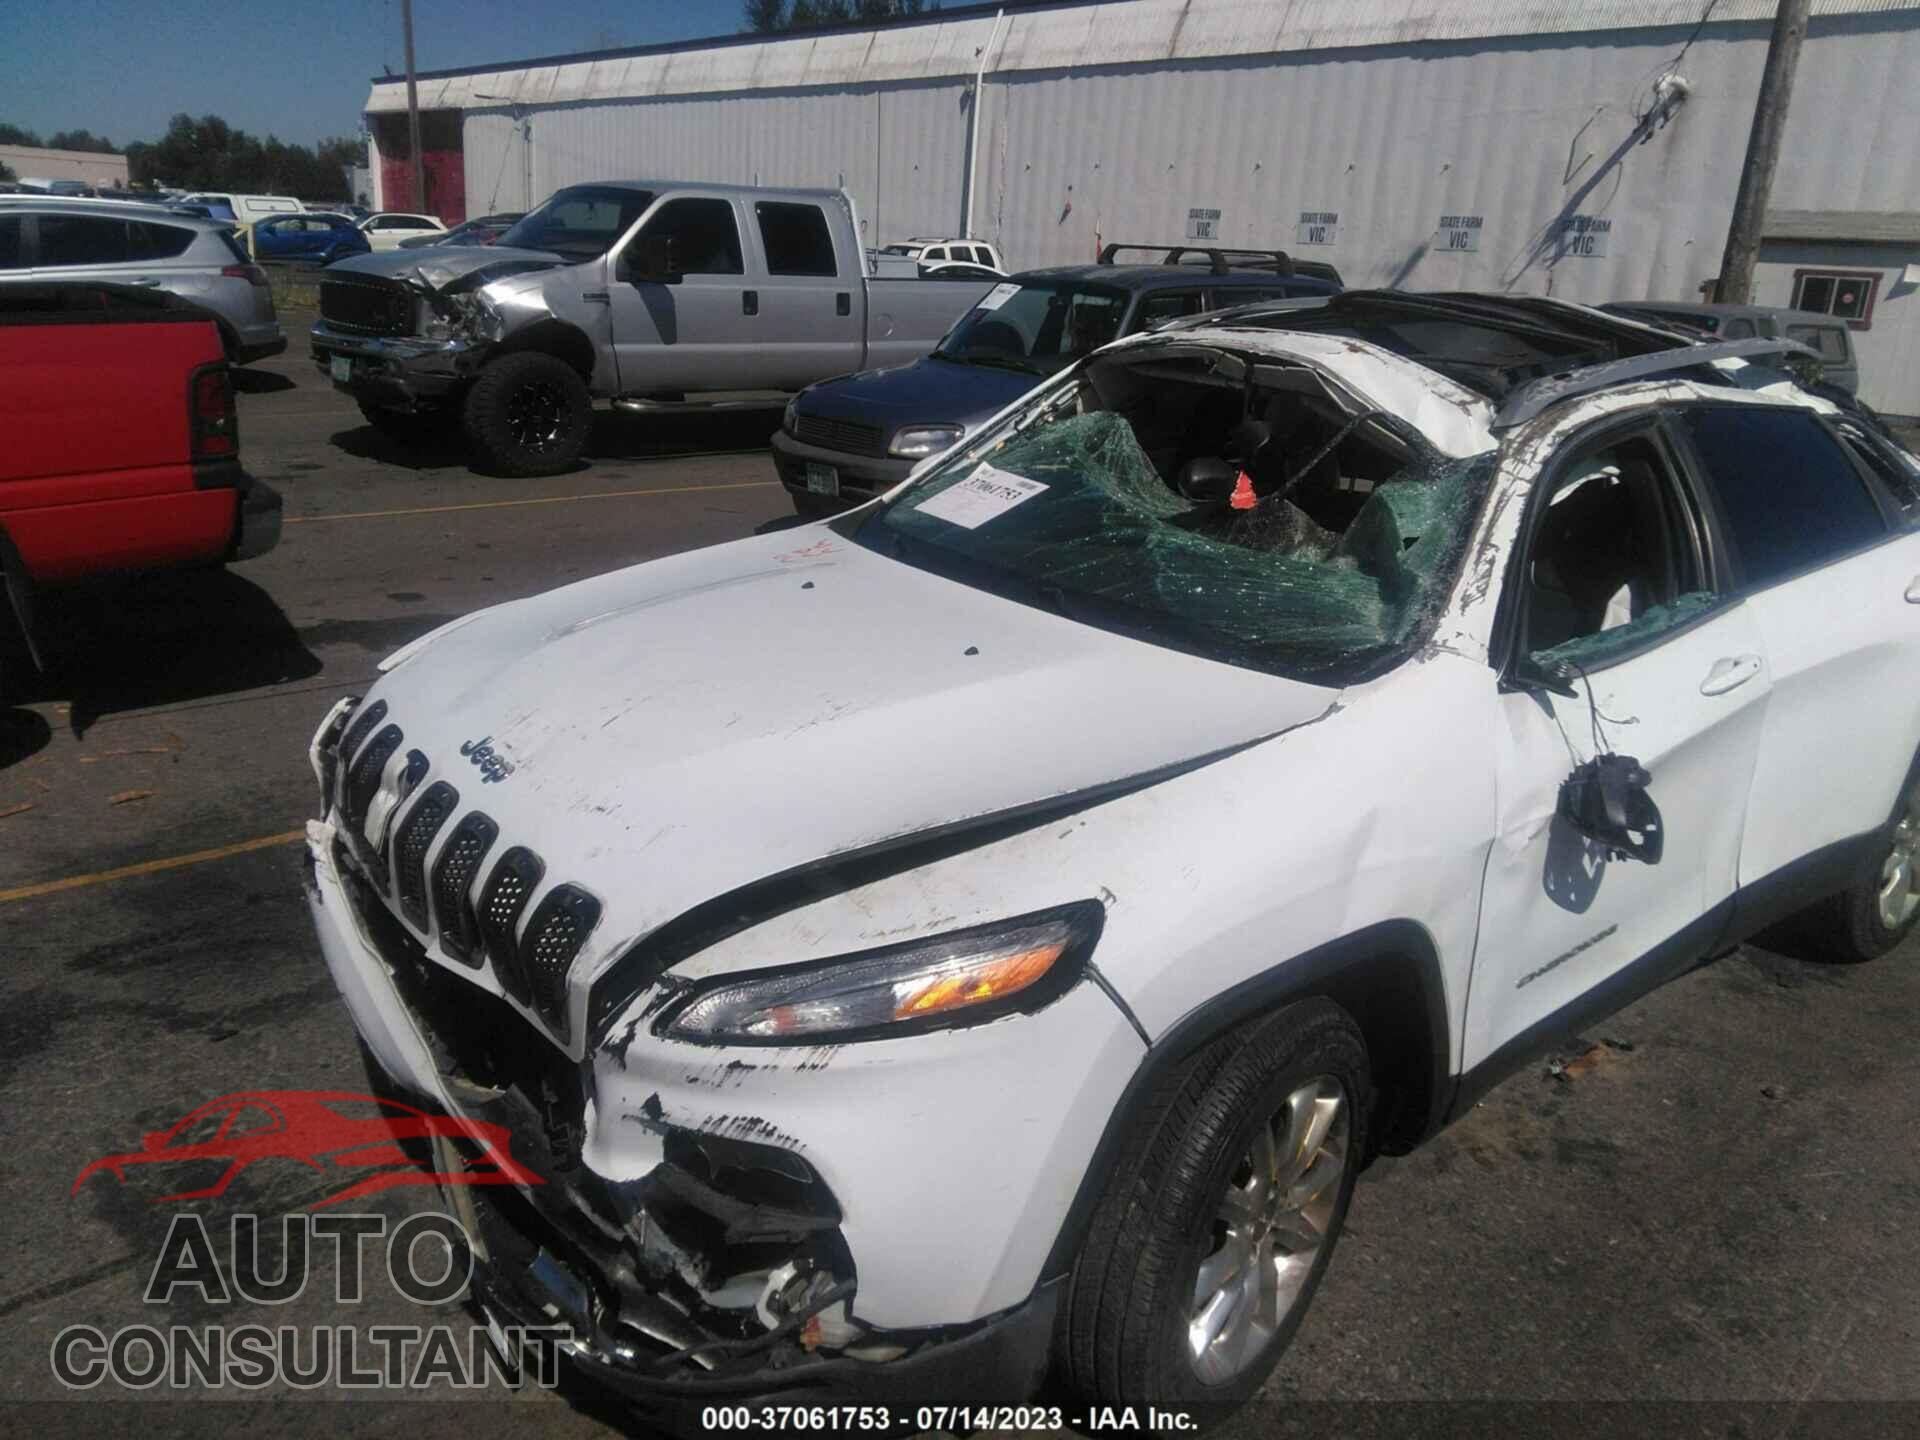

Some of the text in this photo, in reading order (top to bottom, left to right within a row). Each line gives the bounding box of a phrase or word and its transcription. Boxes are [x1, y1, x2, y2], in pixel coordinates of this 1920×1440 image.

[1196, 221, 1211, 237] VIC
[1440, 216, 1483, 228] STATE FARM
[1309, 226, 1326, 242] VIC
[1450, 231, 1468, 249] VIC
[1573, 235, 1594, 254] VIC
[460, 735, 515, 784] Jeep
